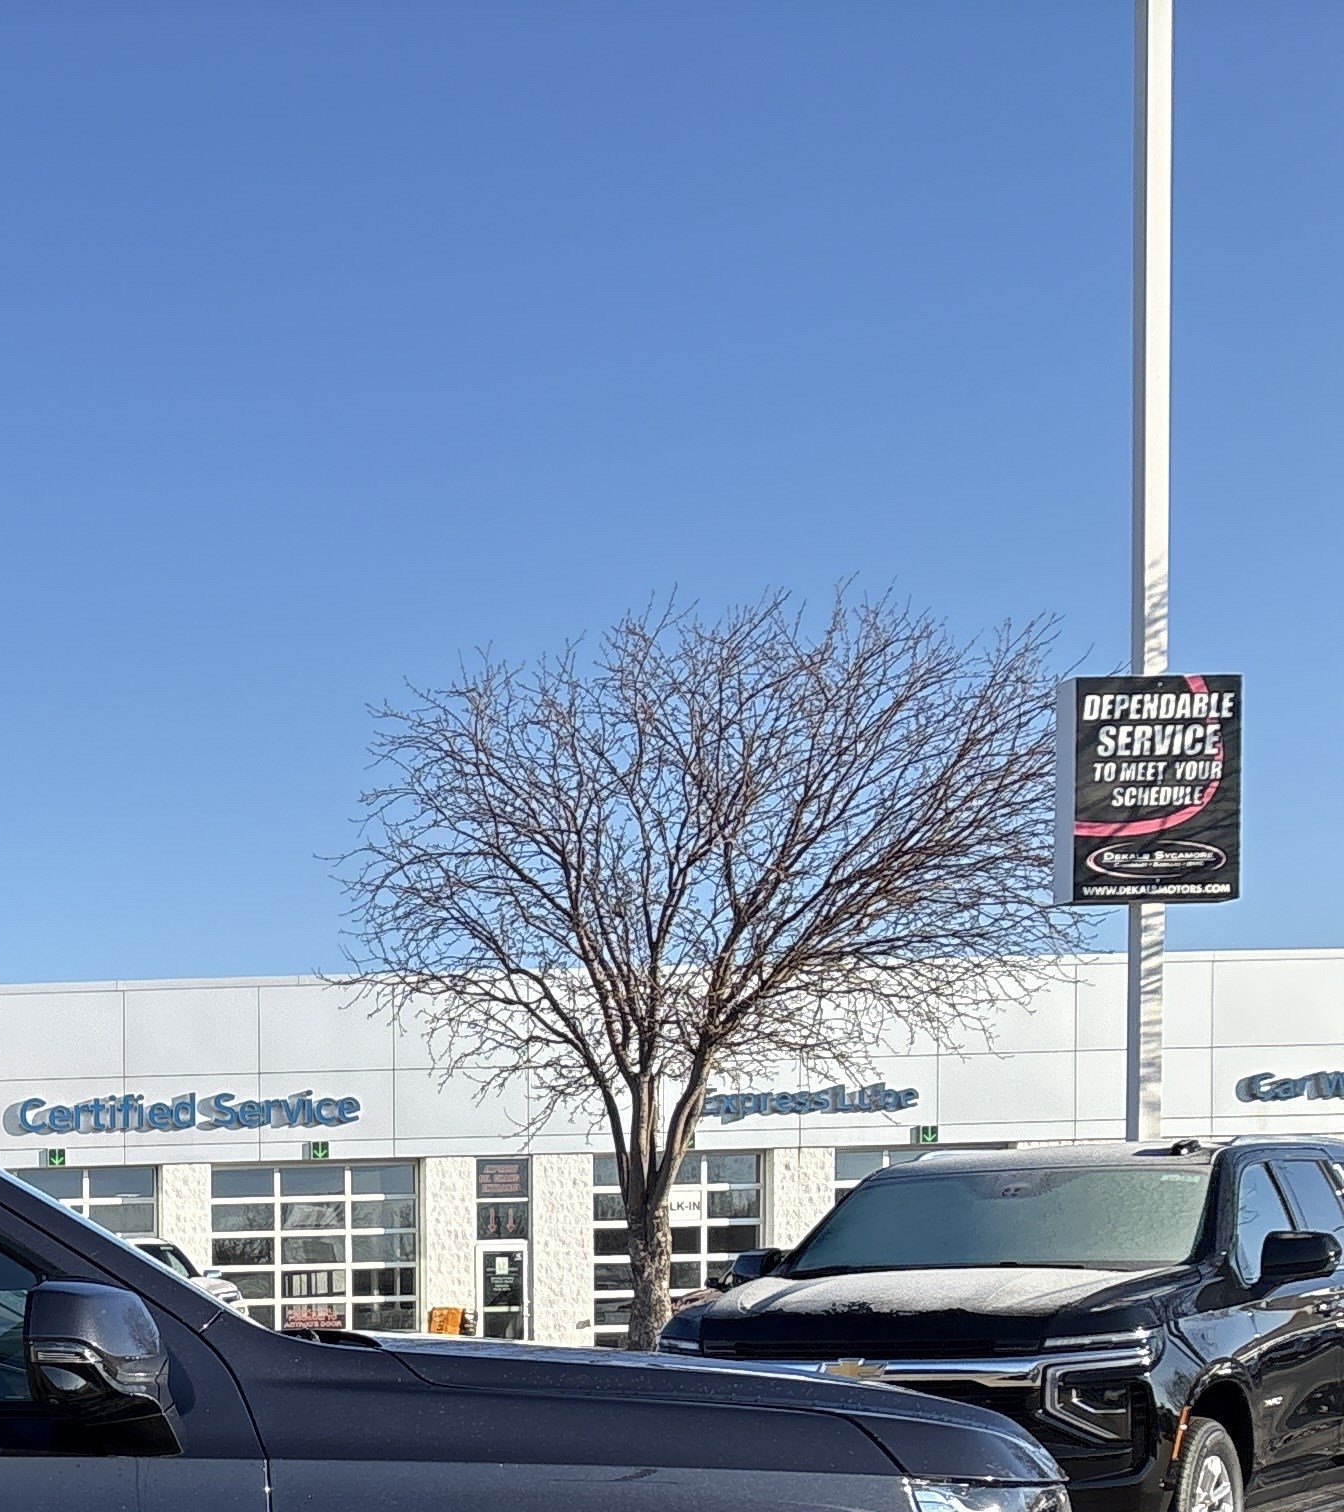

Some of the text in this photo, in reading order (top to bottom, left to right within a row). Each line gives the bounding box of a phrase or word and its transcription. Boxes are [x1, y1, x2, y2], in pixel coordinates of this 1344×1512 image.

[1082, 692, 1235, 721] DEPENDABLE
[1096, 723, 1222, 757] SERVICE
[1093, 760, 1223, 782] TO MEET YOUR
[1112, 786, 1204, 807] SCHEDULE
[18, 1089, 361, 1133] Certified Service
[669, 1201, 701, 1211] LK-IN
